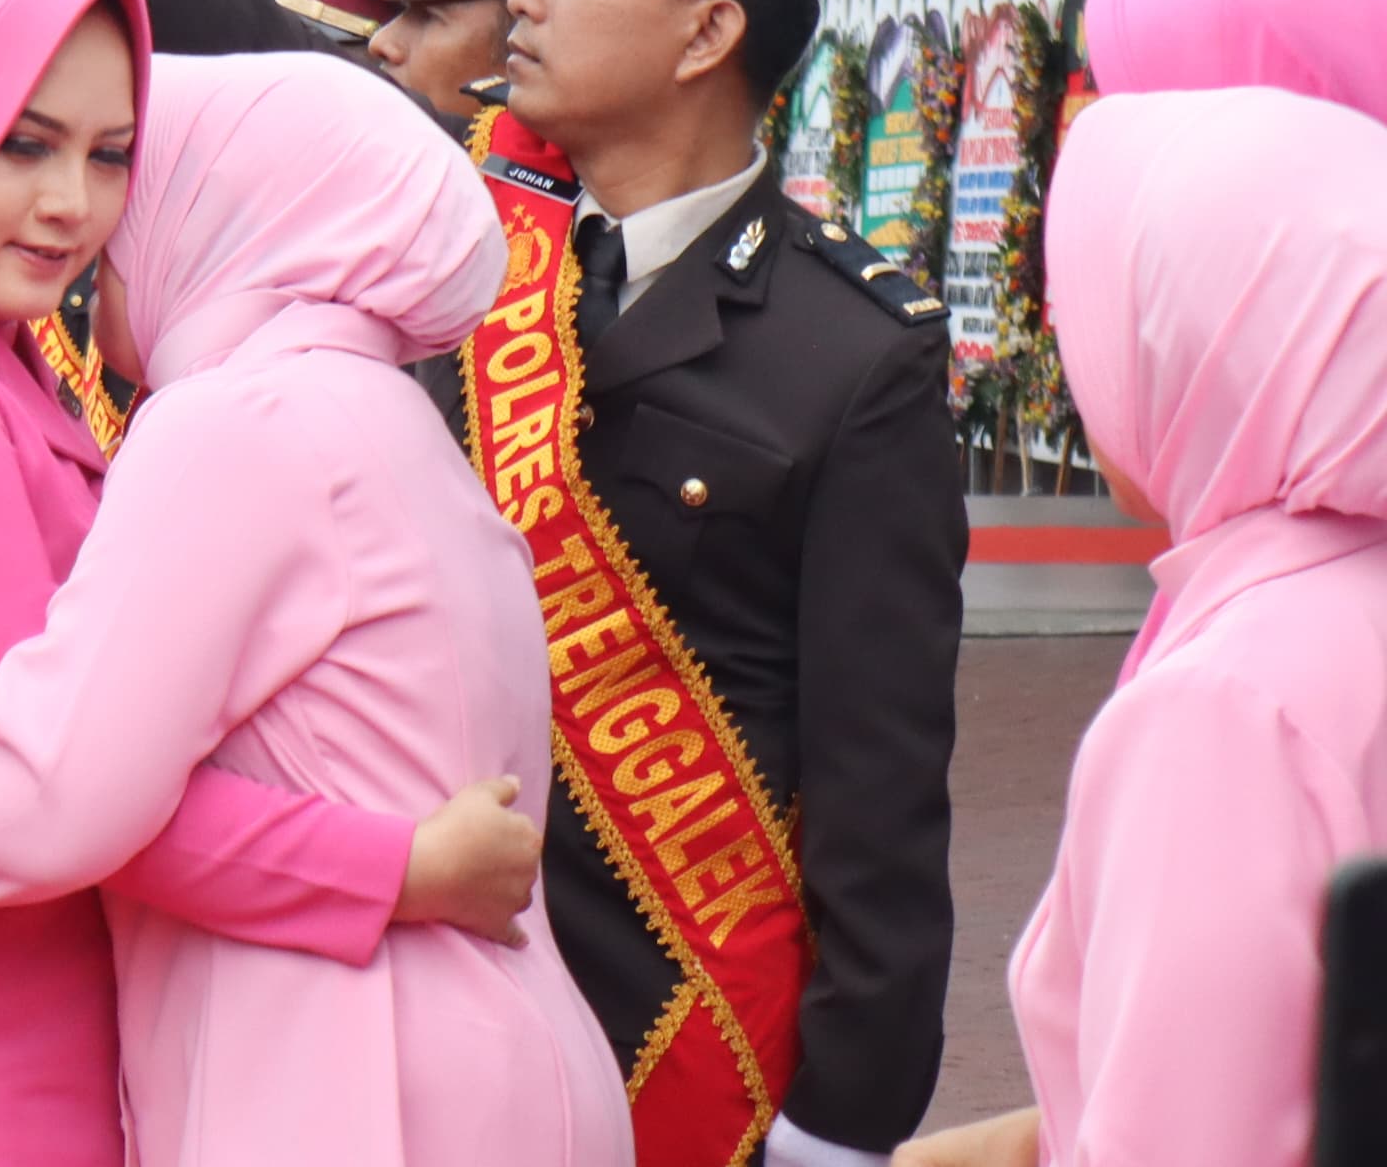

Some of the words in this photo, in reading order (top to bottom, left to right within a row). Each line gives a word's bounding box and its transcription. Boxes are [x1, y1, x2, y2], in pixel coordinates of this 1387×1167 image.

[508, 167, 554, 190] JOHAN
[484, 289, 564, 533] POLRES
[533, 533, 783, 950] TRENGGALEK
